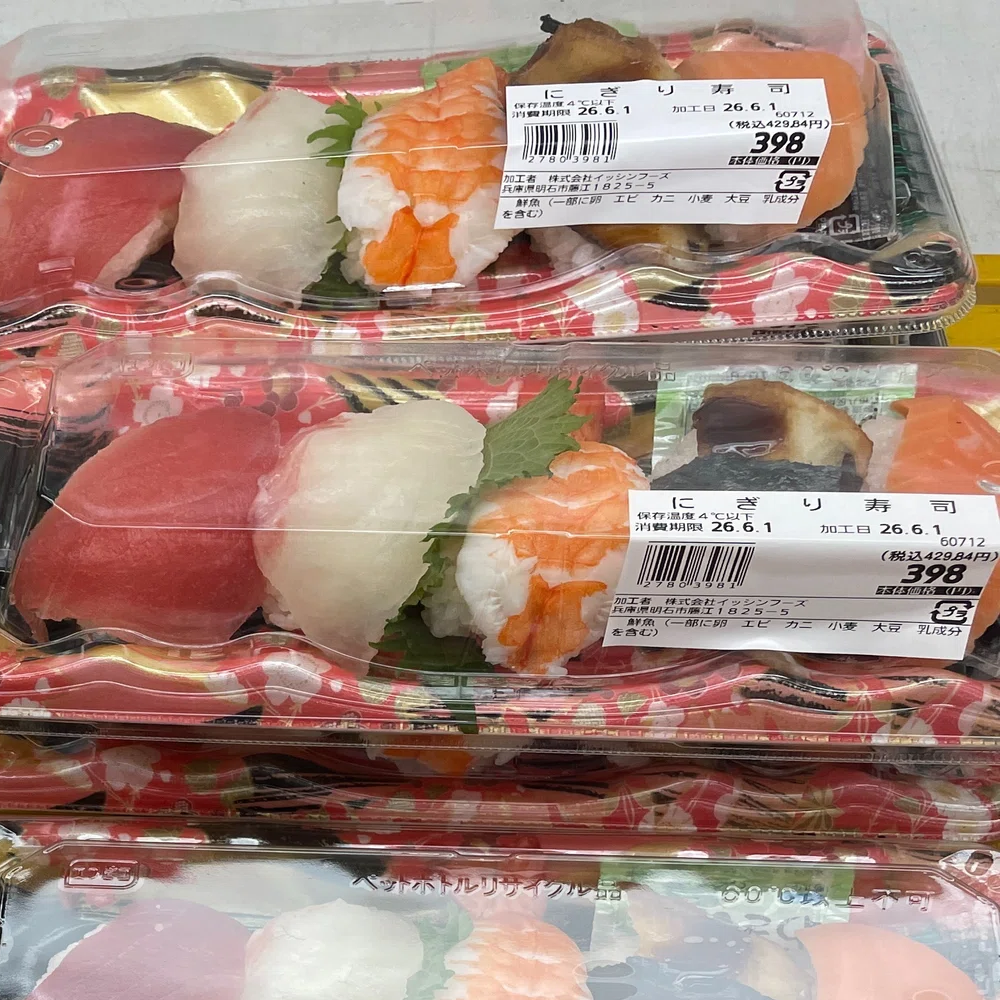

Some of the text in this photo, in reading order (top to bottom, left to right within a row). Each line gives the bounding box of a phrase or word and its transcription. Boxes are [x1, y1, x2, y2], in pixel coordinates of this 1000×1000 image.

[544, 82, 791, 99] にぎり寿司
[511, 102, 777, 118] 消費期限 26.6.1 加工日 26.6.1
[749, 132, 806, 154] 398
[503, 174, 536, 183] 加工者
[515, 198, 540, 207] 鮮魚
[614, 195, 639, 203] エビ
[651, 195, 675, 203] カニ
[687, 194, 713, 203] 小麦
[725, 195, 750, 203] 大豆
[763, 195, 800, 203] 乳成分
[502, 209, 544, 219] を含む)
[672, 496, 957, 514] にぎり寿司
[637, 511, 755, 520] 保存温度4℃以下
[635, 522, 942, 535] 消費期限 26.6.1 加工日 26.6.1
[939, 537, 986, 547] 60712
[899, 564, 967, 584] 398
[614, 597, 651, 605] 加工者
[611, 627, 659, 637] を含む)
[627, 618, 655, 627] 鮮魚
[742, 620, 769, 628] エビ
[785, 621, 813, 629] カニ
[827, 621, 857, 631] 小麦
[872, 623, 901, 632] 大豆
[917, 625, 963, 636] 乳成分
